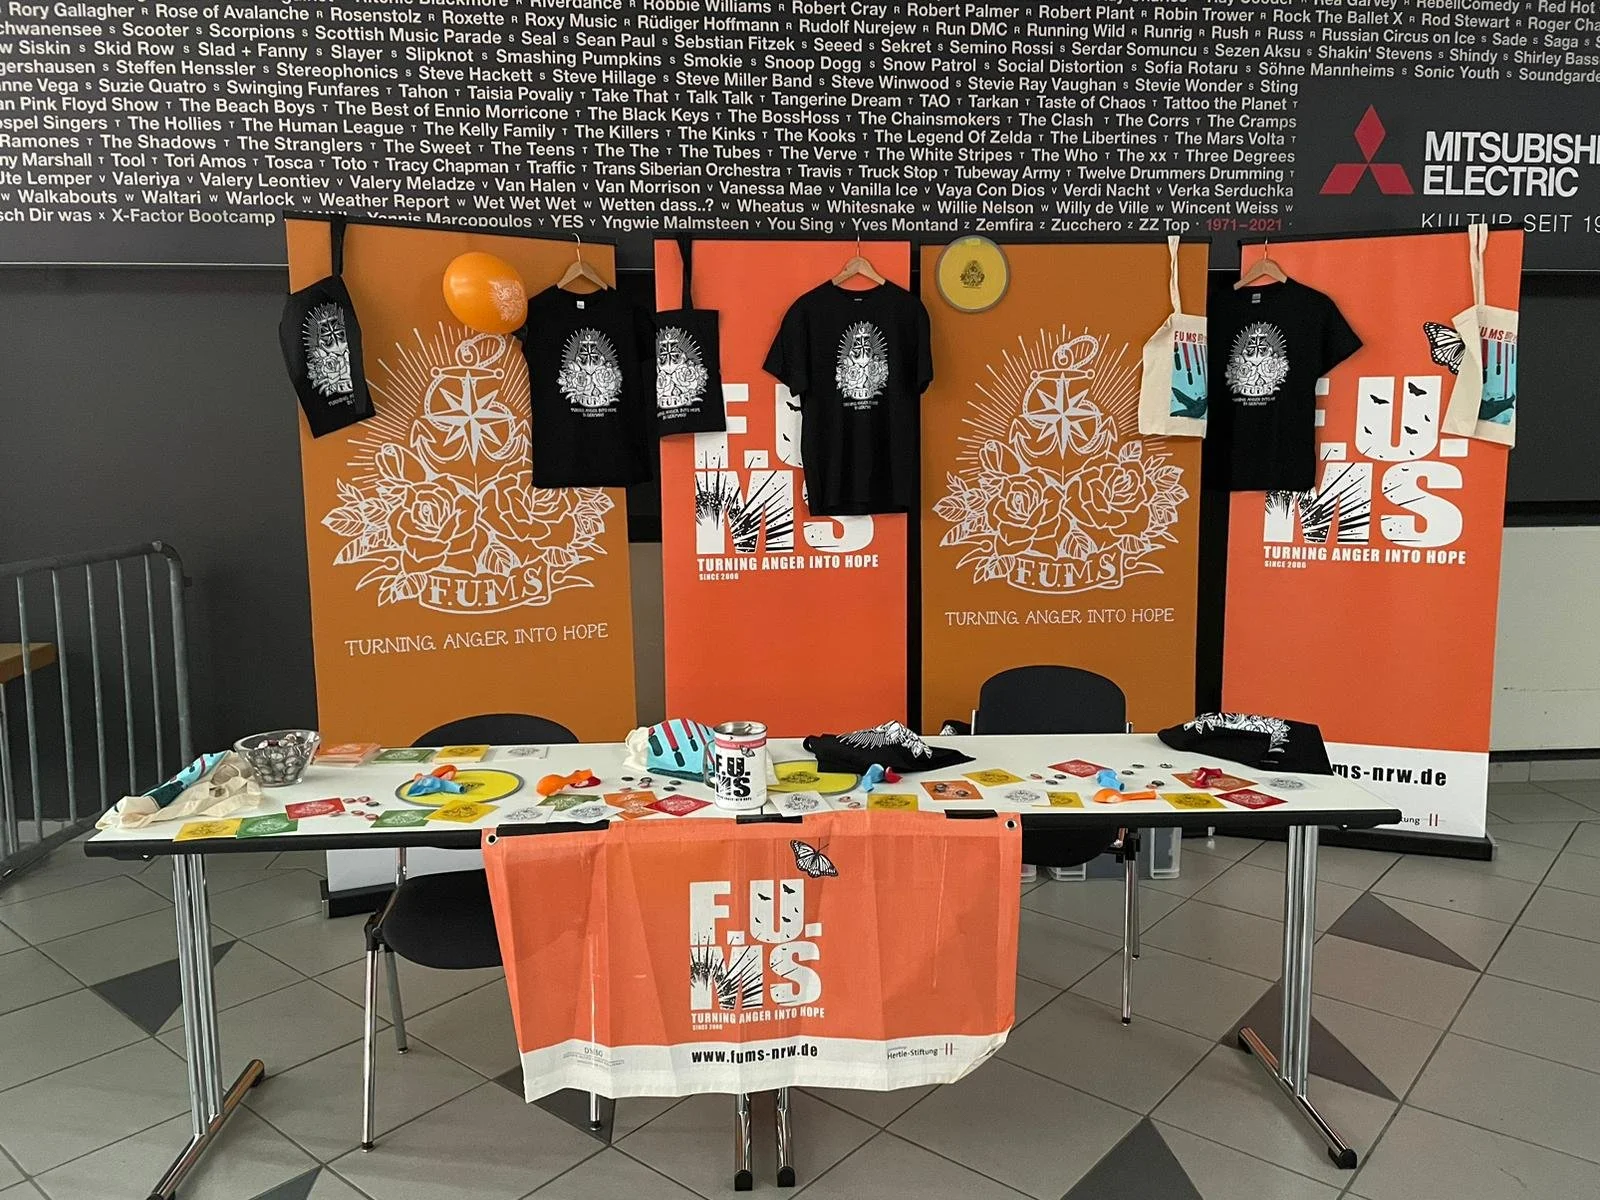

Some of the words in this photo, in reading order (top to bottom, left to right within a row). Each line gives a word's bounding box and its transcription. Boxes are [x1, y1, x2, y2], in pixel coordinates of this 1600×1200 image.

[8, 1, 49, 20] Rory
[54, 2, 135, 21] Gallagher
[330, 7, 422, 23] Rosenstolz
[792, 0, 846, 15] Robert
[850, 1, 887, 19] Cray
[1154, 7, 1198, 20] Robin
[1202, 7, 1254, 21] Trower
[704, 16, 779, 32] Hoffmann
[1422, 13, 1450, 26] Rod
[1454, 14, 1510, 28] Stewart
[209, 23, 295, 41] Scorpions
[576, 32, 616, 47] Sean
[621, 33, 655, 47] Paul
[1027, 23, 1088, 40] Running
[1093, 24, 1125, 37] Wild
[1268, 27, 1304, 40] Russ
[18, 39, 71, 55] Siskin
[881, 39, 932, 53] Sekret
[1544, 34, 1578, 50] Saga
[406, 46, 474, 65] Slipknot
[1215, 43, 1260, 57] Sezen
[1264, 44, 1300, 58] Aksu
[1449, 48, 1498, 65] Shindy
[276, 62, 398, 81] Stereophonics
[764, 55, 815, 72] Snoop
[820, 56, 861, 73] Dogg
[1144, 60, 1182, 74] Sofia
[1188, 61, 1238, 74] Rotaru
[1310, 63, 1394, 77] Mannheims
[1414, 64, 1454, 78] Sonic
[1460, 66, 1499, 79] Youth
[418, 65, 464, 80] Steve
[469, 67, 533, 82] Hackett
[226, 79, 303, 99] Swinging
[308, 81, 380, 97] Funfares
[831, 74, 874, 89] Steve
[878, 75, 949, 90] Winwood
[1260, 79, 1298, 96] Sting
[592, 88, 629, 102] Take
[632, 89, 669, 103] That
[919, 94, 950, 108] TAO
[1163, 96, 1210, 110] Tattoo
[1214, 97, 1237, 110] the
[1242, 97, 1287, 110] Planet
[178, 98, 211, 112] The
[216, 98, 269, 113] Beach
[274, 99, 315, 117] Boys
[728, 109, 757, 123] The
[762, 110, 840, 124] BossHoss
[1116, 113, 1144, 127] The
[1148, 113, 1189, 127] Corrs
[423, 121, 454, 136] The
[459, 122, 499, 140] Kelly
[503, 123, 556, 141] Family
[774, 128, 803, 142] The
[808, 128, 856, 142] Kooks
[1175, 131, 1202, 145] The
[1207, 132, 1244, 145] Mars
[1248, 132, 1284, 145] Volta
[236, 136, 270, 150] The
[274, 136, 363, 155] Stranglers
[594, 143, 625, 157] The
[629, 143, 660, 157] The
[110, 152, 146, 167] Tool
[331, 156, 367, 171] Toto
[876, 147, 905, 161] The
[909, 147, 954, 161] White
[958, 148, 1012, 164] Stripes
[1185, 149, 1228, 162] Three
[1233, 149, 1295, 165] Degrees
[593, 161, 636, 175] Trans
[640, 162, 702, 176] Siberian
[706, 163, 780, 177] Orchestra
[954, 165, 1019, 182] Tubeway
[1022, 166, 1061, 182] Army
[349, 174, 402, 192] Valery
[406, 176, 476, 191] Meladze
[719, 181, 784, 195] Vanessa
[790, 182, 822, 195] Mae
[1423, 165, 1579, 197] ELECTRIC
[17, 189, 118, 204] Walkabouts
[141, 190, 201, 204] Waltari
[1063, 183, 1101, 197] Verdi
[1106, 183, 1150, 196] Nacht
[473, 195, 505, 209] Wet
[509, 196, 541, 210] Wet
[545, 196, 576, 210] Wet
[826, 200, 915, 214] Whitesnake
[1171, 201, 1231, 214] Wincent
[1235, 201, 1278, 214] Weiss
[112, 208, 184, 222] X-Factor
[189, 209, 275, 226] Bootcamp
[550, 214, 584, 228] YES
[602, 215, 659, 232] Yngwie
[664, 216, 749, 230] Malmsteen
[976, 218, 1033, 231] Zemfira
[1051, 218, 1122, 231] Zucchero
[1523, 213, 1573, 233] SEIT
[1263, 461, 1463, 547] MS
[697, 558, 757, 571] TURNING
[761, 557, 805, 570] ANGER
[809, 556, 840, 569] INTO
[845, 554, 879, 568] HOPE
[1263, 546, 1327, 560] TURNING
[1331, 548, 1380, 562] ANGER
[1385, 549, 1420, 563] INTO
[1426, 550, 1466, 565] HOPE
[1264, 560, 1286, 568] SINCE
[945, 611, 1020, 626] TURNING
[1025, 610, 1083, 625] ANGER
[1088, 609, 1127, 623] INTO
[1131, 608, 1175, 622] HOPE
[344, 634, 436, 656] TURNING
[443, 631, 509, 650] ANGER
[514, 626, 557, 645] INTO
[563, 623, 609, 641] HOPE
[1333, 762, 1447, 786] ms-nrw.de
[690, 878, 822, 945] F.U.
[690, 941, 822, 1011] MS
[691, 1013, 736, 1024] TURNING
[739, 1010, 771, 1024] ANGER
[774, 1008, 797, 1021] INTO
[800, 1006, 825, 1018] HOPE
[691, 1043, 818, 1064] www.fums-nrw.de
